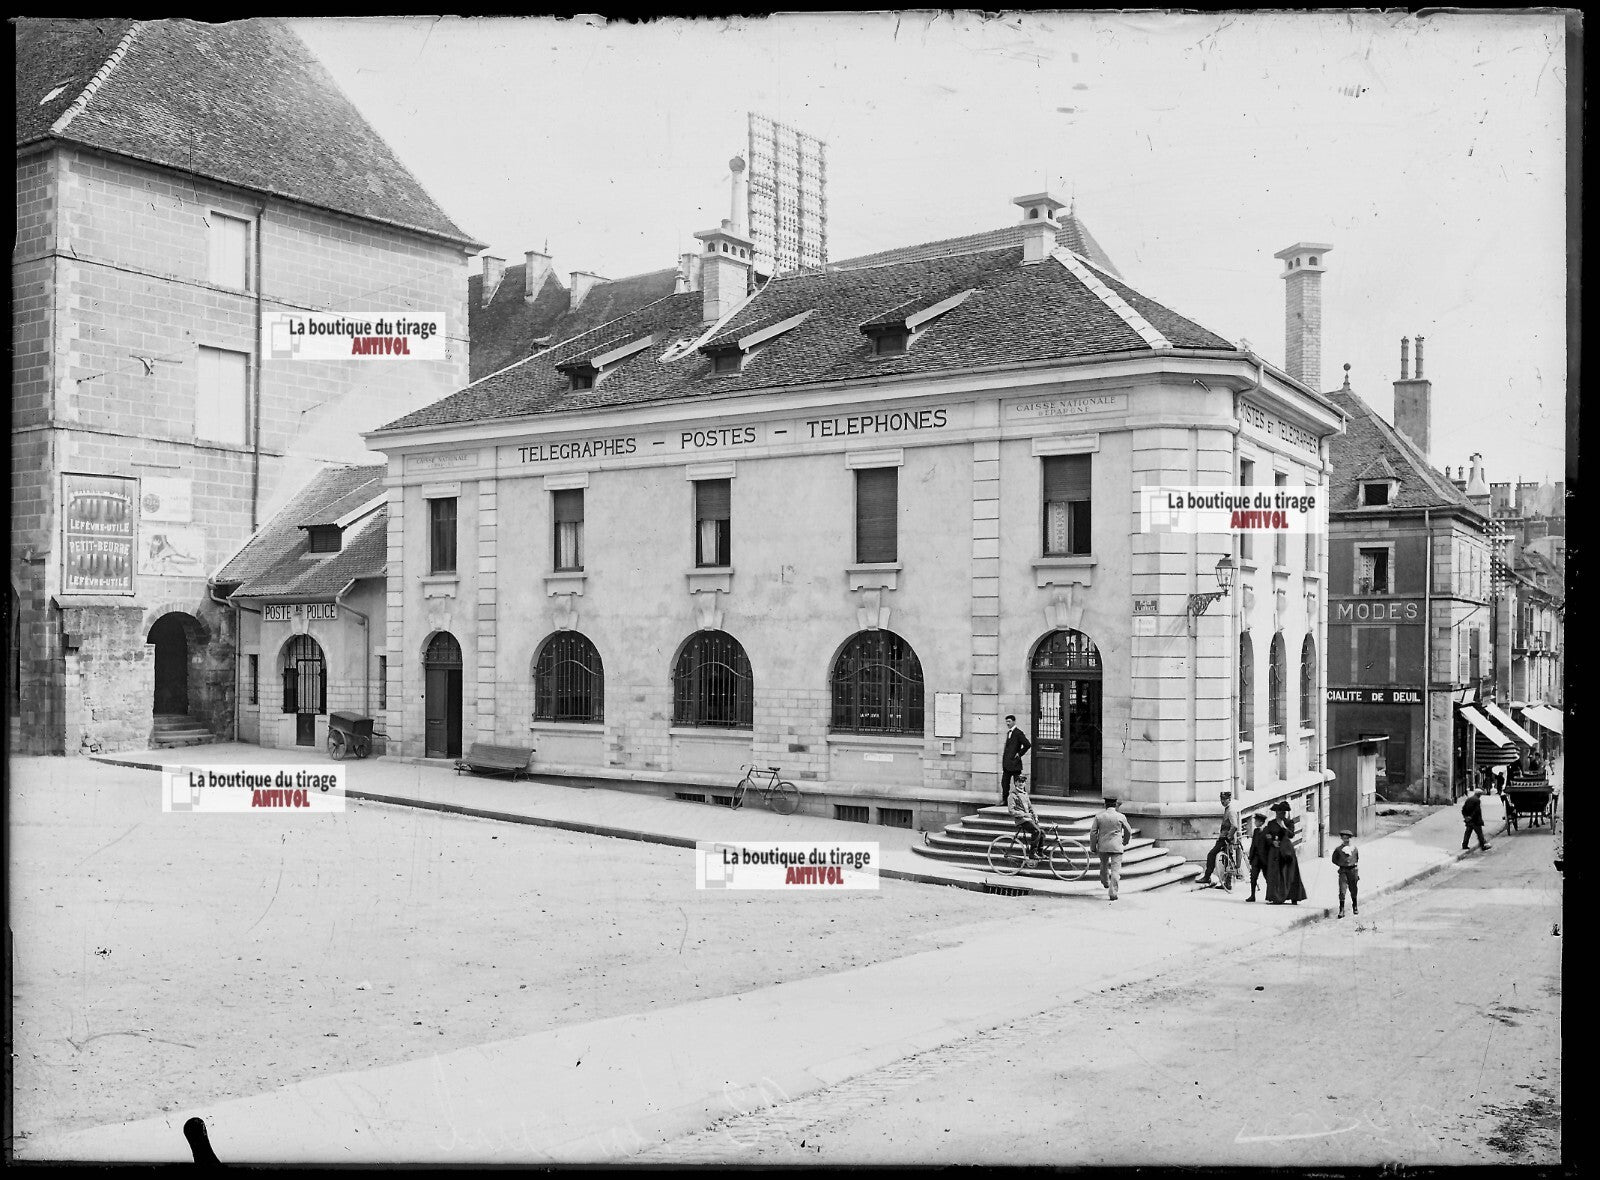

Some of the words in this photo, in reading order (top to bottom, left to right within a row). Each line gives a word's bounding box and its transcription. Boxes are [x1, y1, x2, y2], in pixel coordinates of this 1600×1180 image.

[1016, 402, 1055, 412] CAISSE
[1060, 396, 1116, 408] NATIONALE
[518, 438, 637, 463] TELEGRAPHES
[681, 427, 756, 449] POSTES
[806, 409, 948, 438] TELEPHONES
[69, 540, 131, 556] PETIT-BEURRE
[265, 605, 291, 619] POSTE
[306, 604, 336, 619] POLICE
[1338, 602, 1418, 620] MODES
[1371, 692, 1384, 701] DE
[1393, 691, 1421, 702] DEUIL
